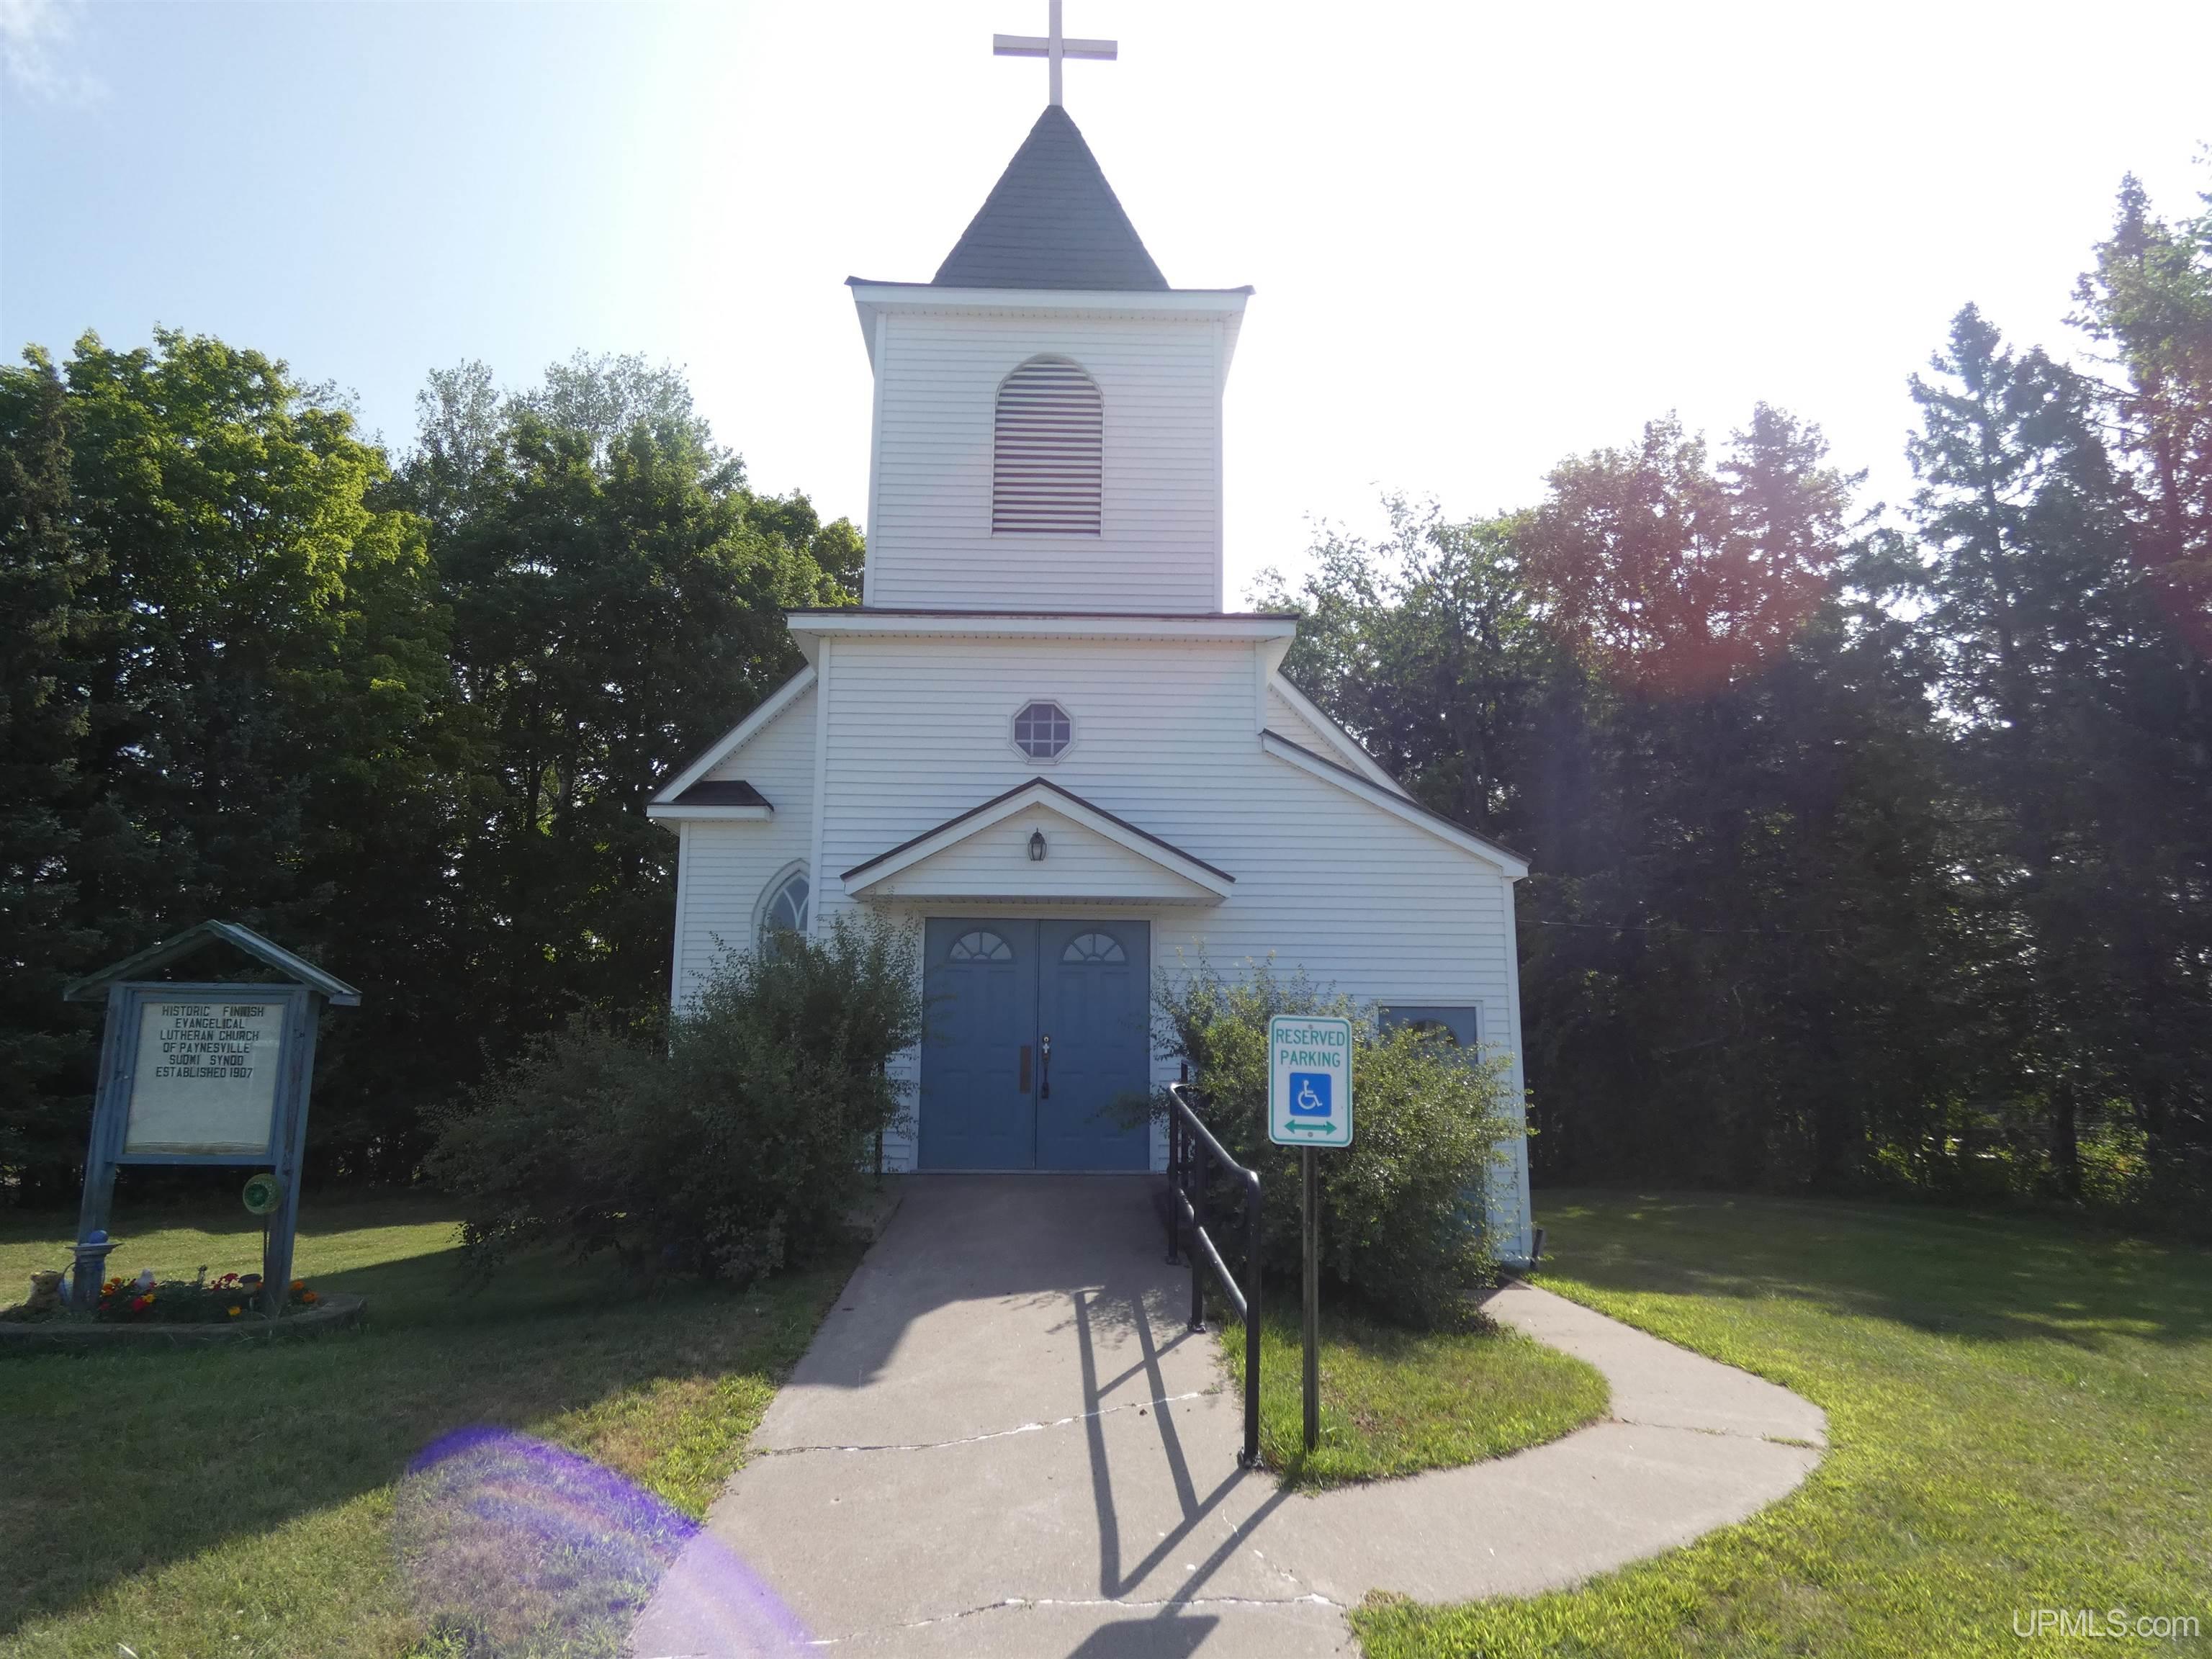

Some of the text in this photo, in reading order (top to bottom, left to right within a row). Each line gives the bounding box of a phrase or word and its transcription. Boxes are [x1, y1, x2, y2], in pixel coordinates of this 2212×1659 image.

[162, 1005, 210, 1017] HISTORIC
[176, 1018, 245, 1029] EVANGELICAL
[160, 1030, 259, 1041] LUTHERAN CHURCH
[1276, 1029, 1345, 1046] RESERVED
[163, 1042, 251, 1053] OF PAYNESVILLE
[169, 1054, 244, 1066] SUOMI SYNOD
[1280, 1050, 1341, 1067] PARKING
[156, 1066, 253, 1078] ESTABLISHED 1907
